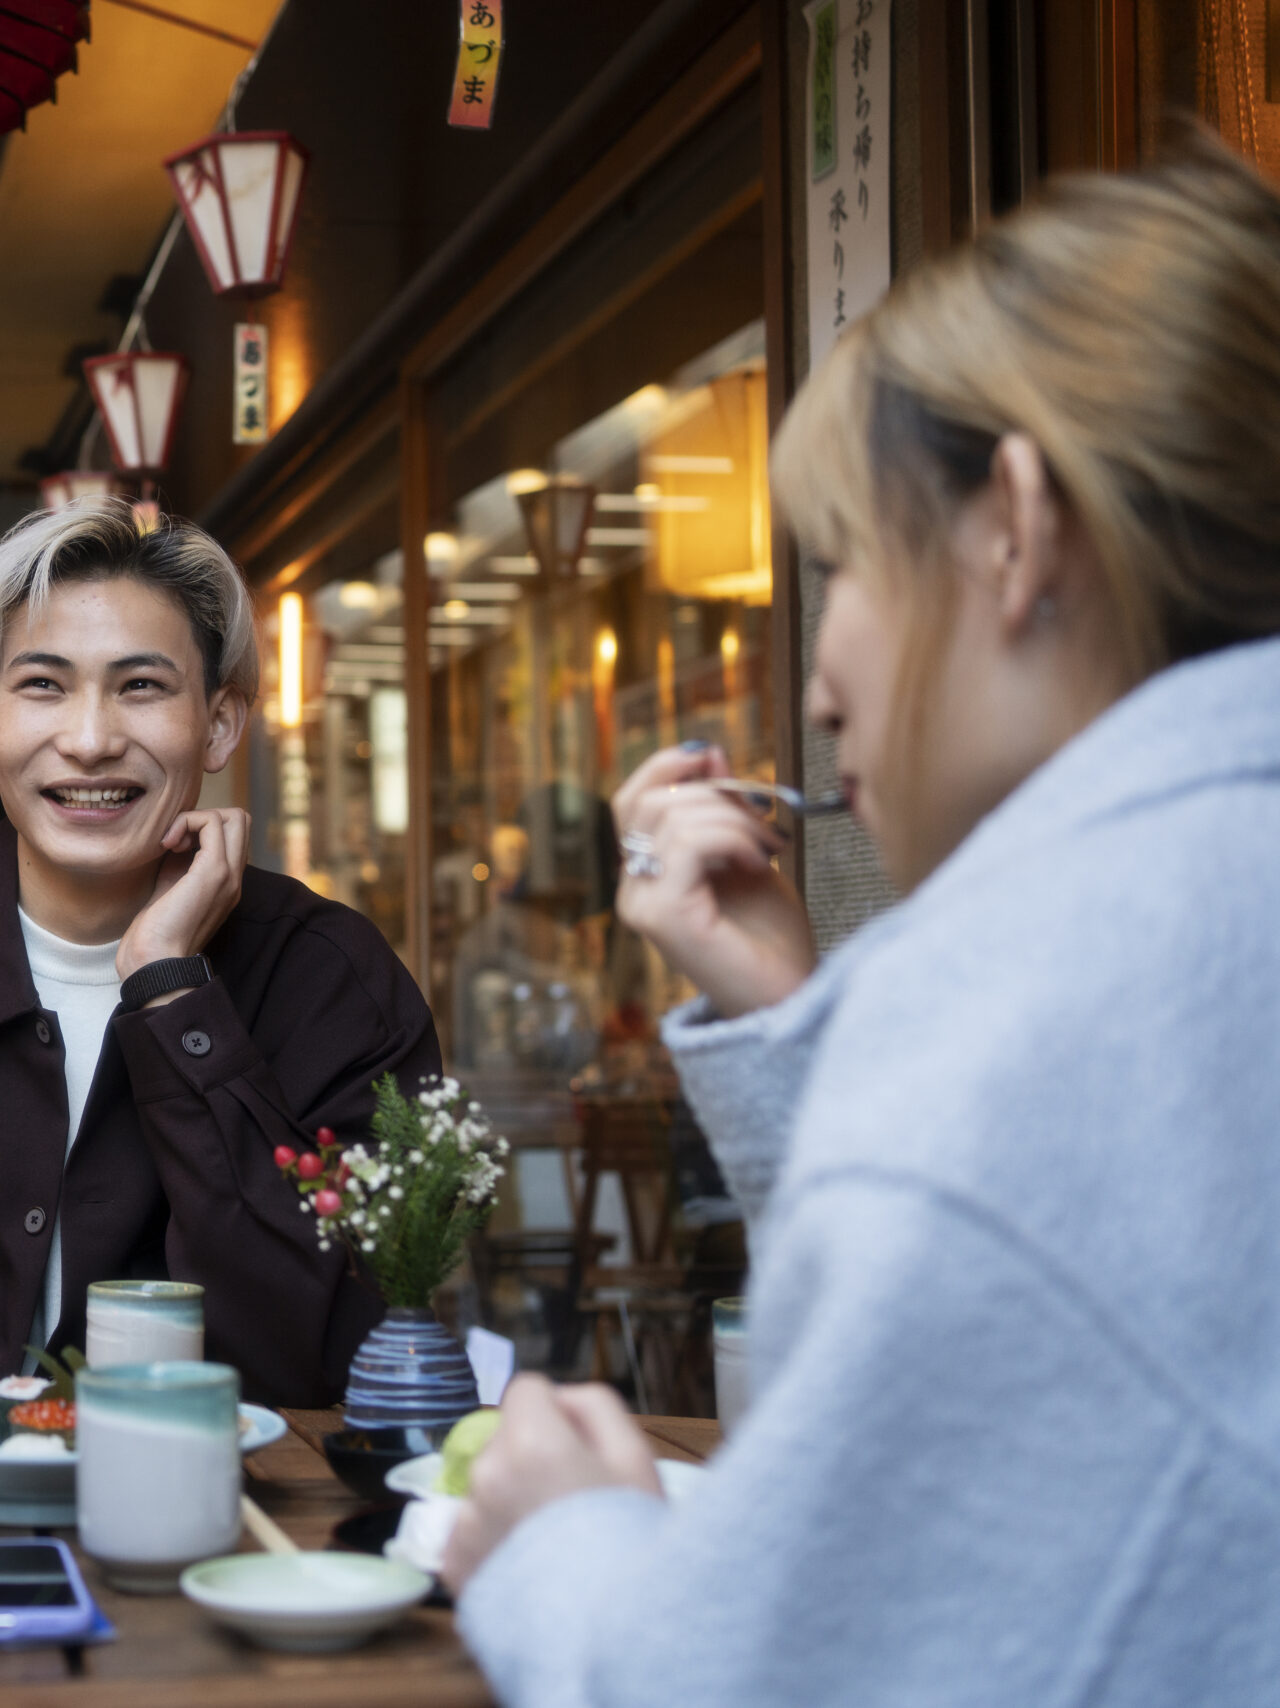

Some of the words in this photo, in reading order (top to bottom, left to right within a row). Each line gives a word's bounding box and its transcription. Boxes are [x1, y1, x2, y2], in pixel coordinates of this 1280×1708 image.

[462, 1, 496, 105] あづま
[829, 188, 849, 338] 承りま
